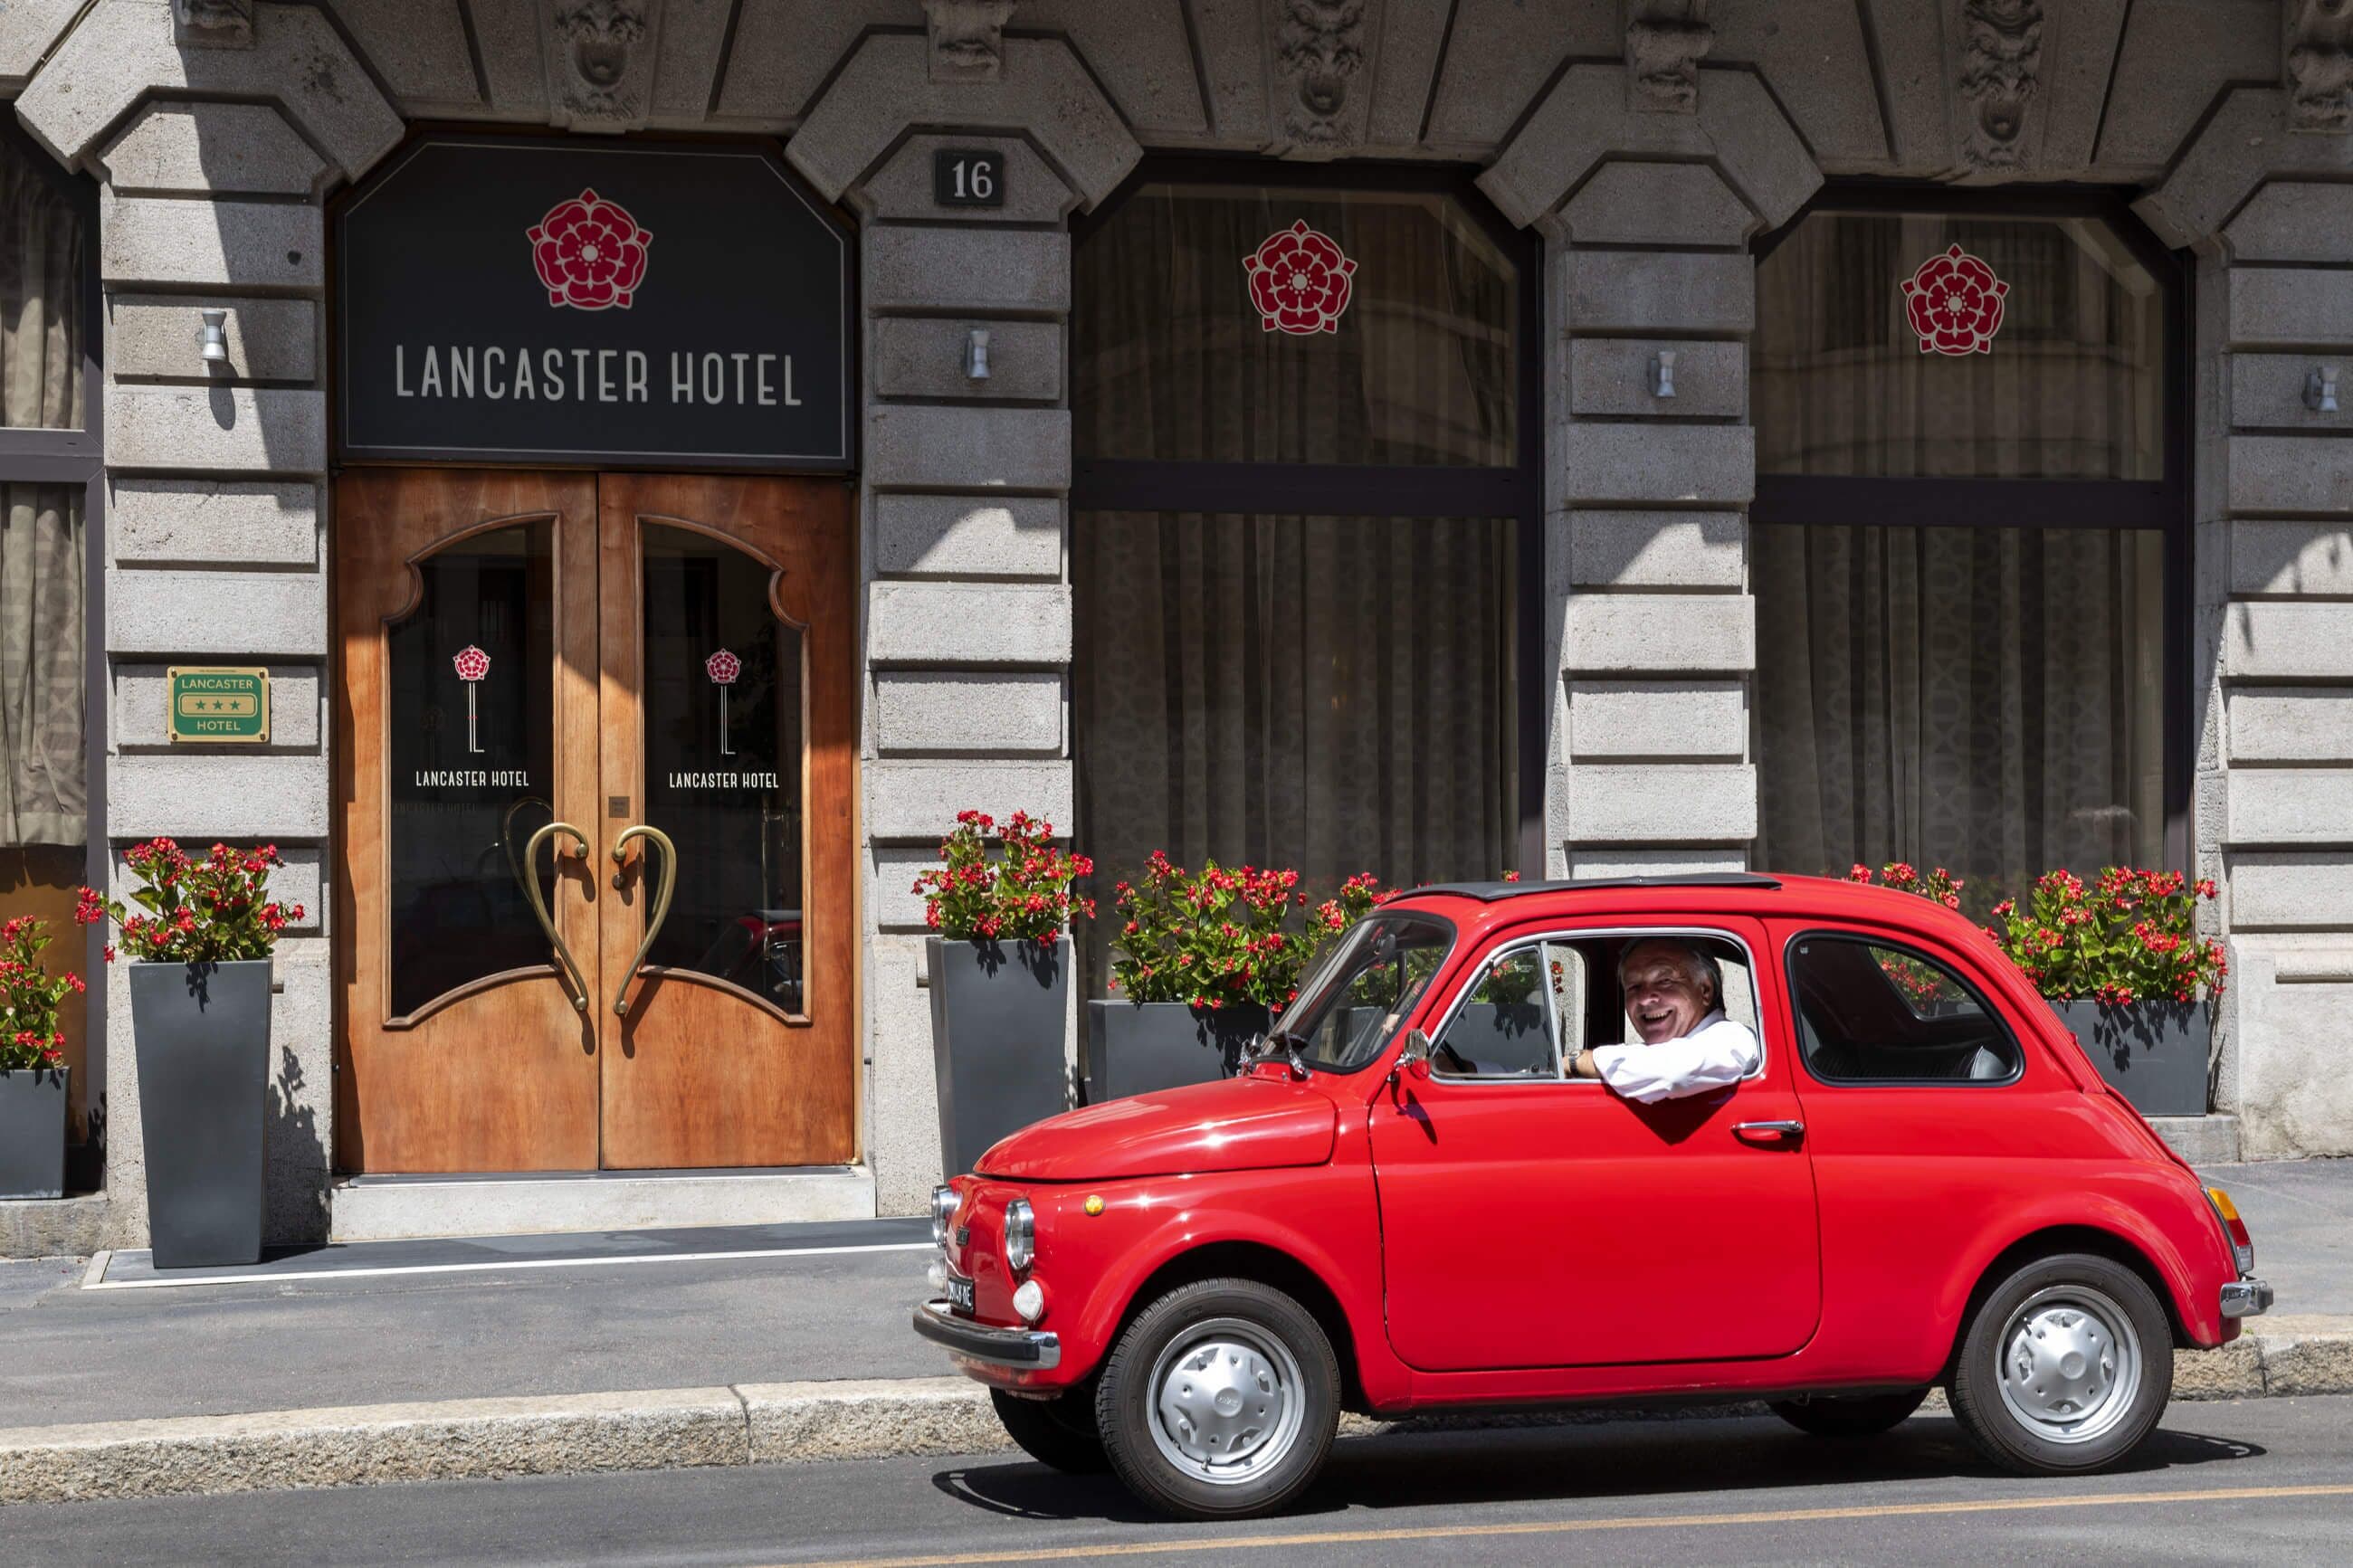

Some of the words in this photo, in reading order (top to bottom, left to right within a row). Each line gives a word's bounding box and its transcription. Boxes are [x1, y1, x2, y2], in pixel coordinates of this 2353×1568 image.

[953, 160, 993, 198] 16
[395, 344, 649, 404] LANCASTER
[671, 351, 803, 406] HOTEL
[181, 679, 253, 689] LANCASTER
[196, 720, 241, 731] HOTEL
[415, 770, 487, 787] LANCASTER
[491, 770, 529, 787] HOTEL
[669, 772, 738, 789] LANCASTER
[742, 772, 779, 789] HOTEL
